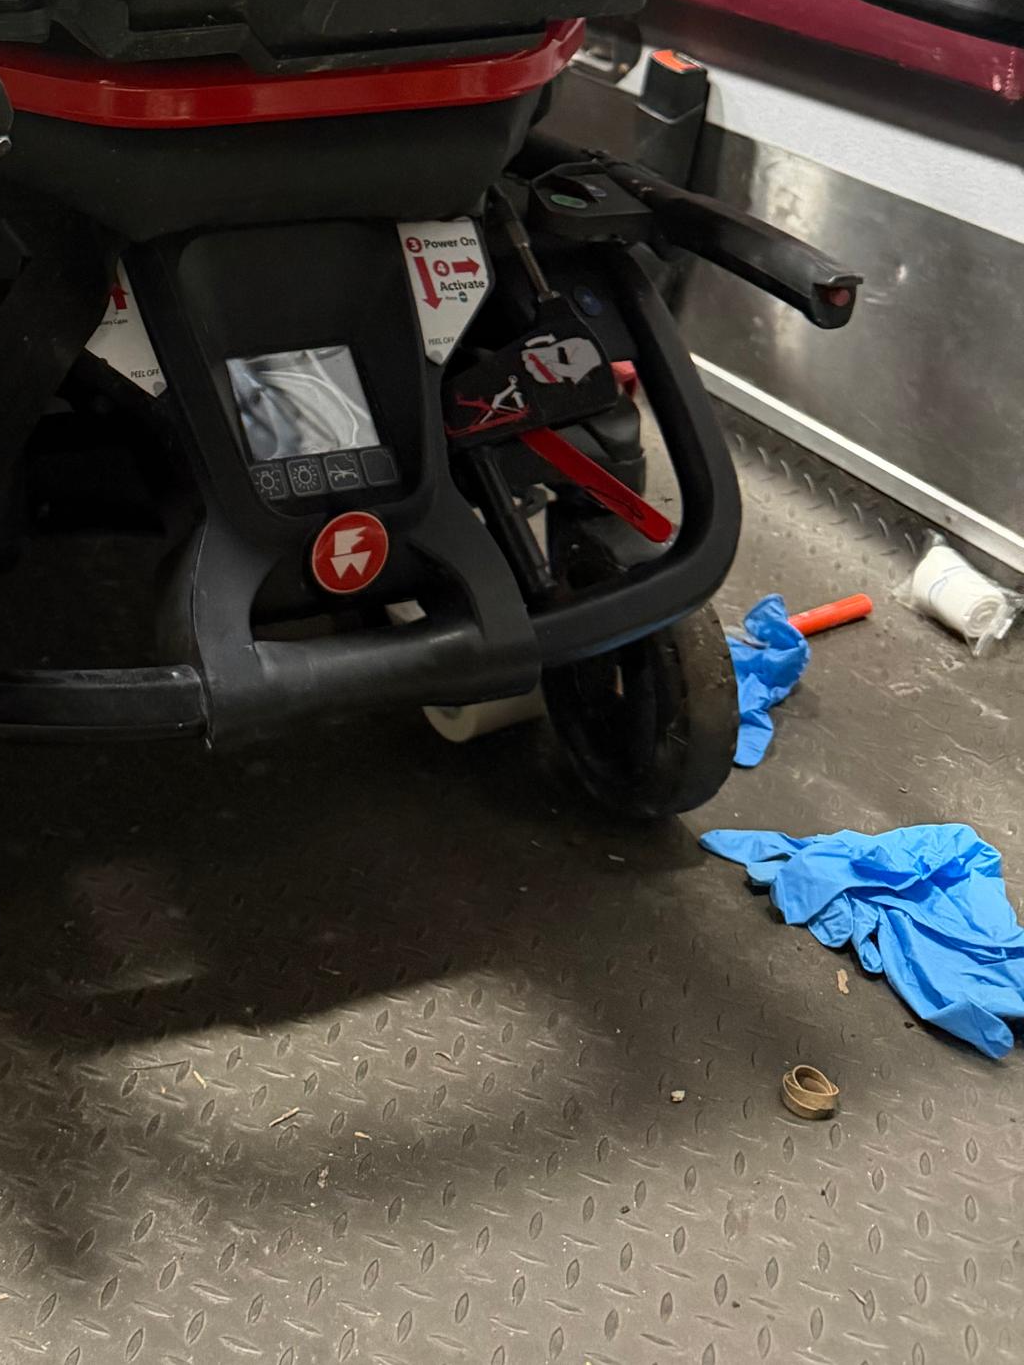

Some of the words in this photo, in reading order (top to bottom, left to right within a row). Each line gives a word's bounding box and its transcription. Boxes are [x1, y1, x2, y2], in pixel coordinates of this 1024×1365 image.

[424, 238, 458, 249] Power
[461, 236, 477, 247] On
[440, 279, 486, 292] Activate
